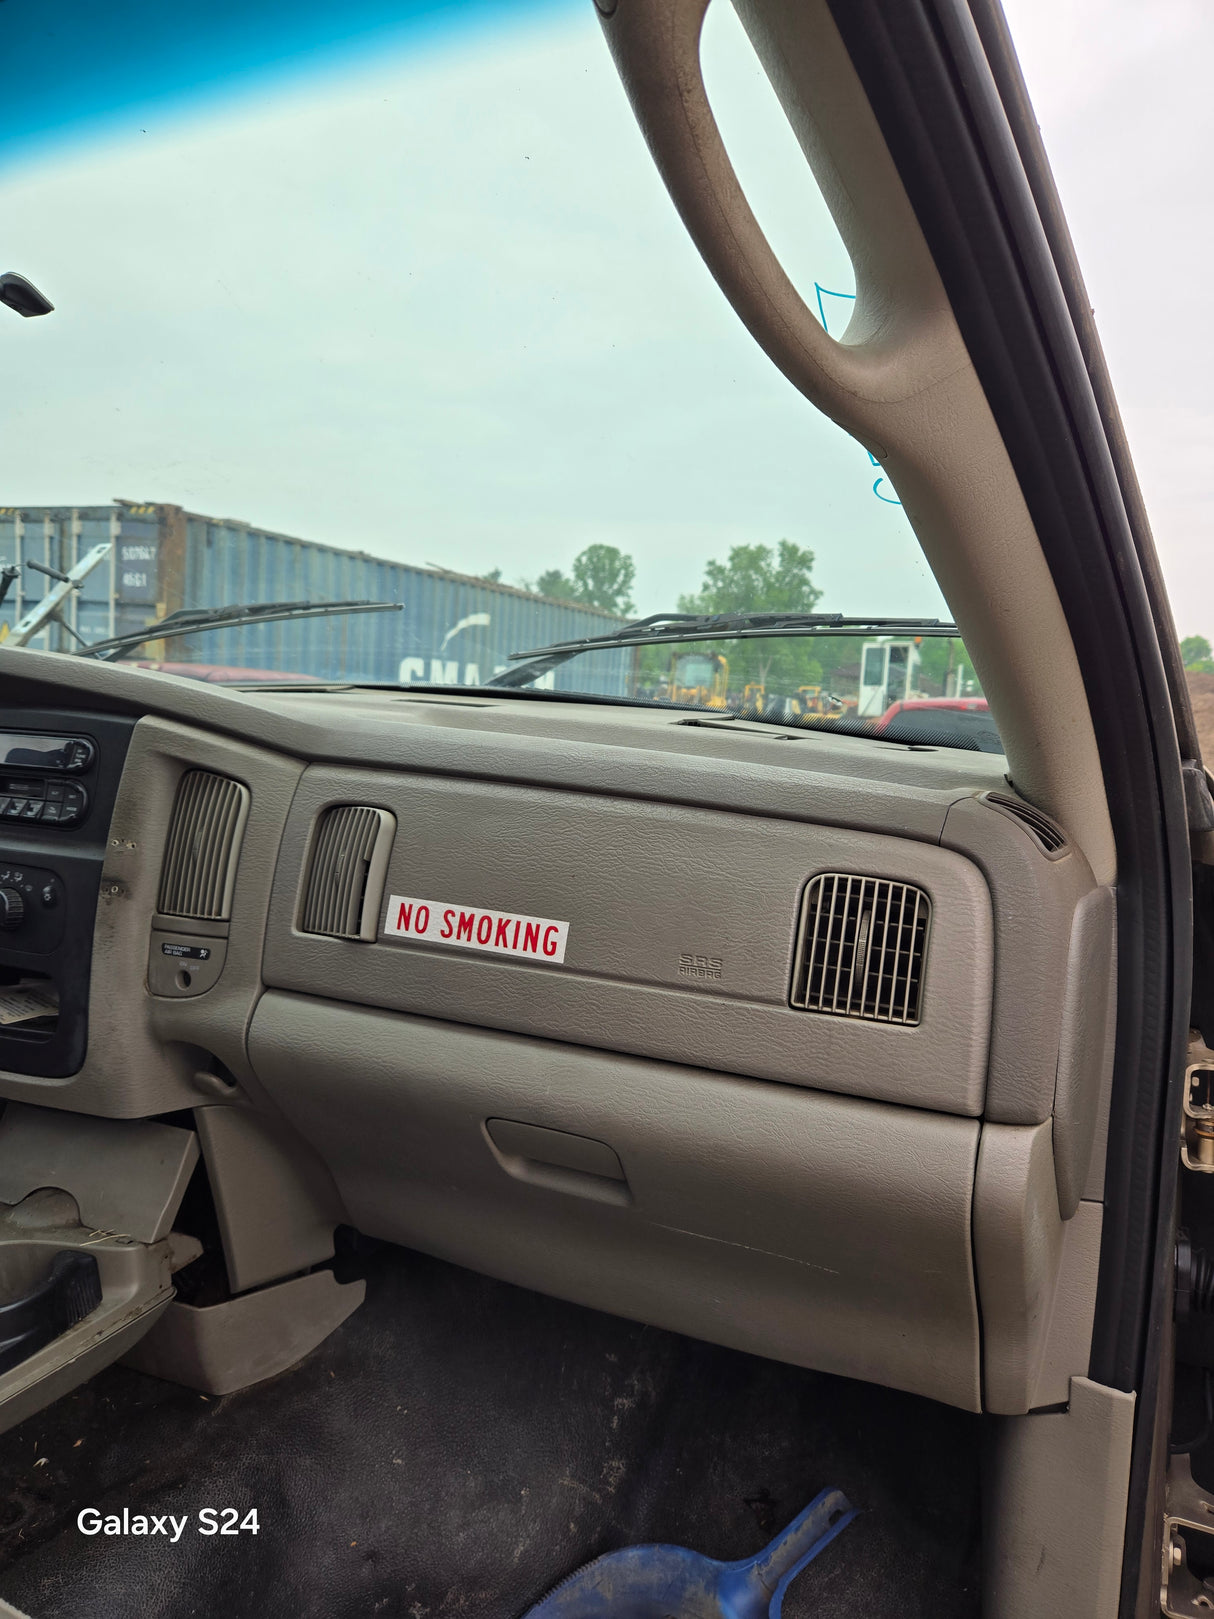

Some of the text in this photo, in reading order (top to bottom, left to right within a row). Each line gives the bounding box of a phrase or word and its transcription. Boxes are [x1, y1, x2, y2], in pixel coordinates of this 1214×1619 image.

[396, 902, 560, 957] NO SMOKING
[164, 944, 191, 953] PASSENGER
[679, 953, 723, 969] SRS
[678, 966, 722, 980] AIRBAG
